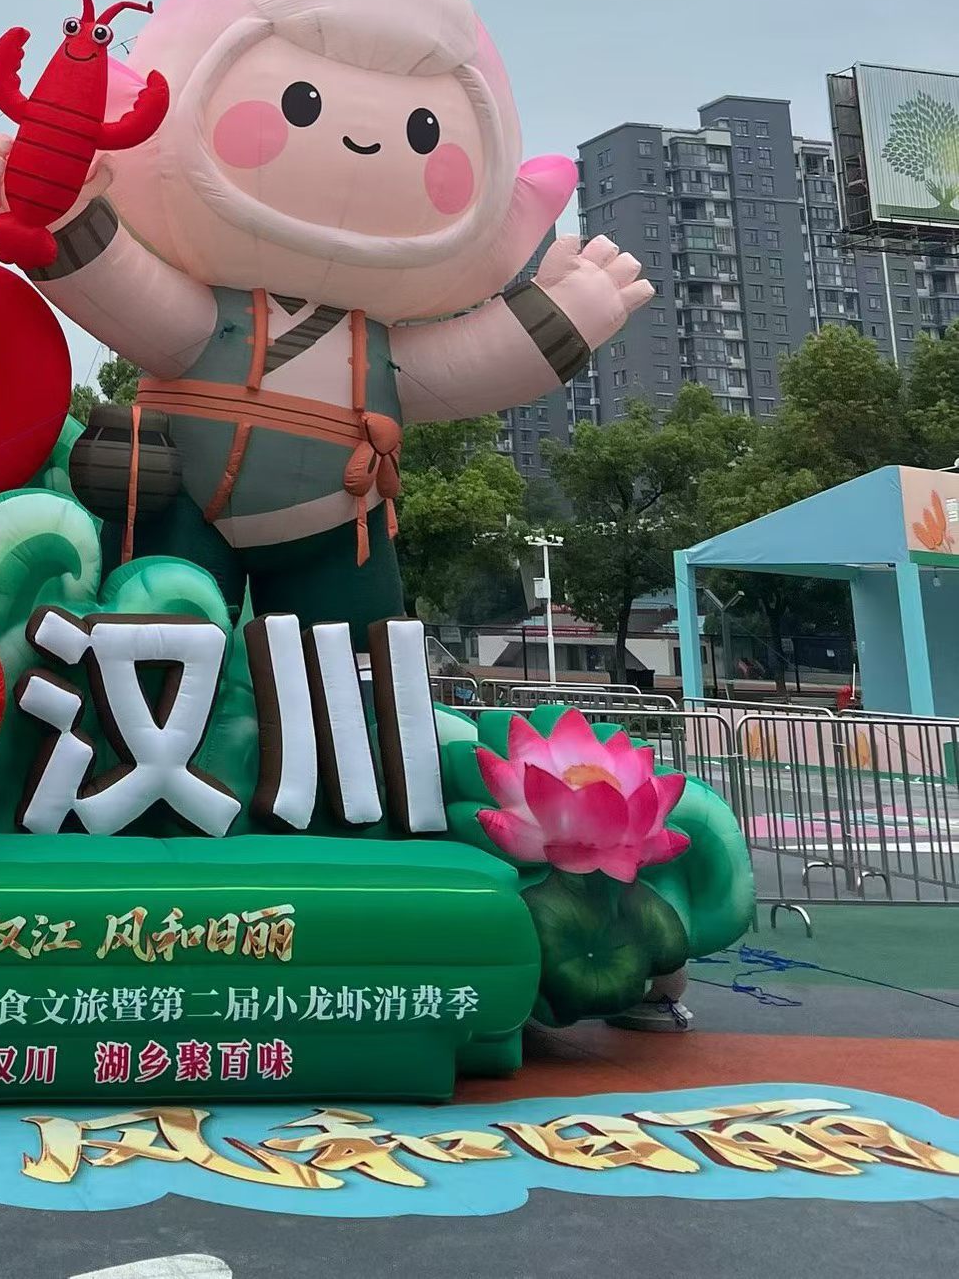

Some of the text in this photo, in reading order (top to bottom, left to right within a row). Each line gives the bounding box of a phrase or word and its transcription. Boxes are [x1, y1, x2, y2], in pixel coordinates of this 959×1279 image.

[16, 606, 448, 838] 汉川
[95, 904, 297, 962] 风和日丽
[94, 1039, 293, 1083] 湖乡聚百味
[21, 1098, 959, 1189] 风和日丽
